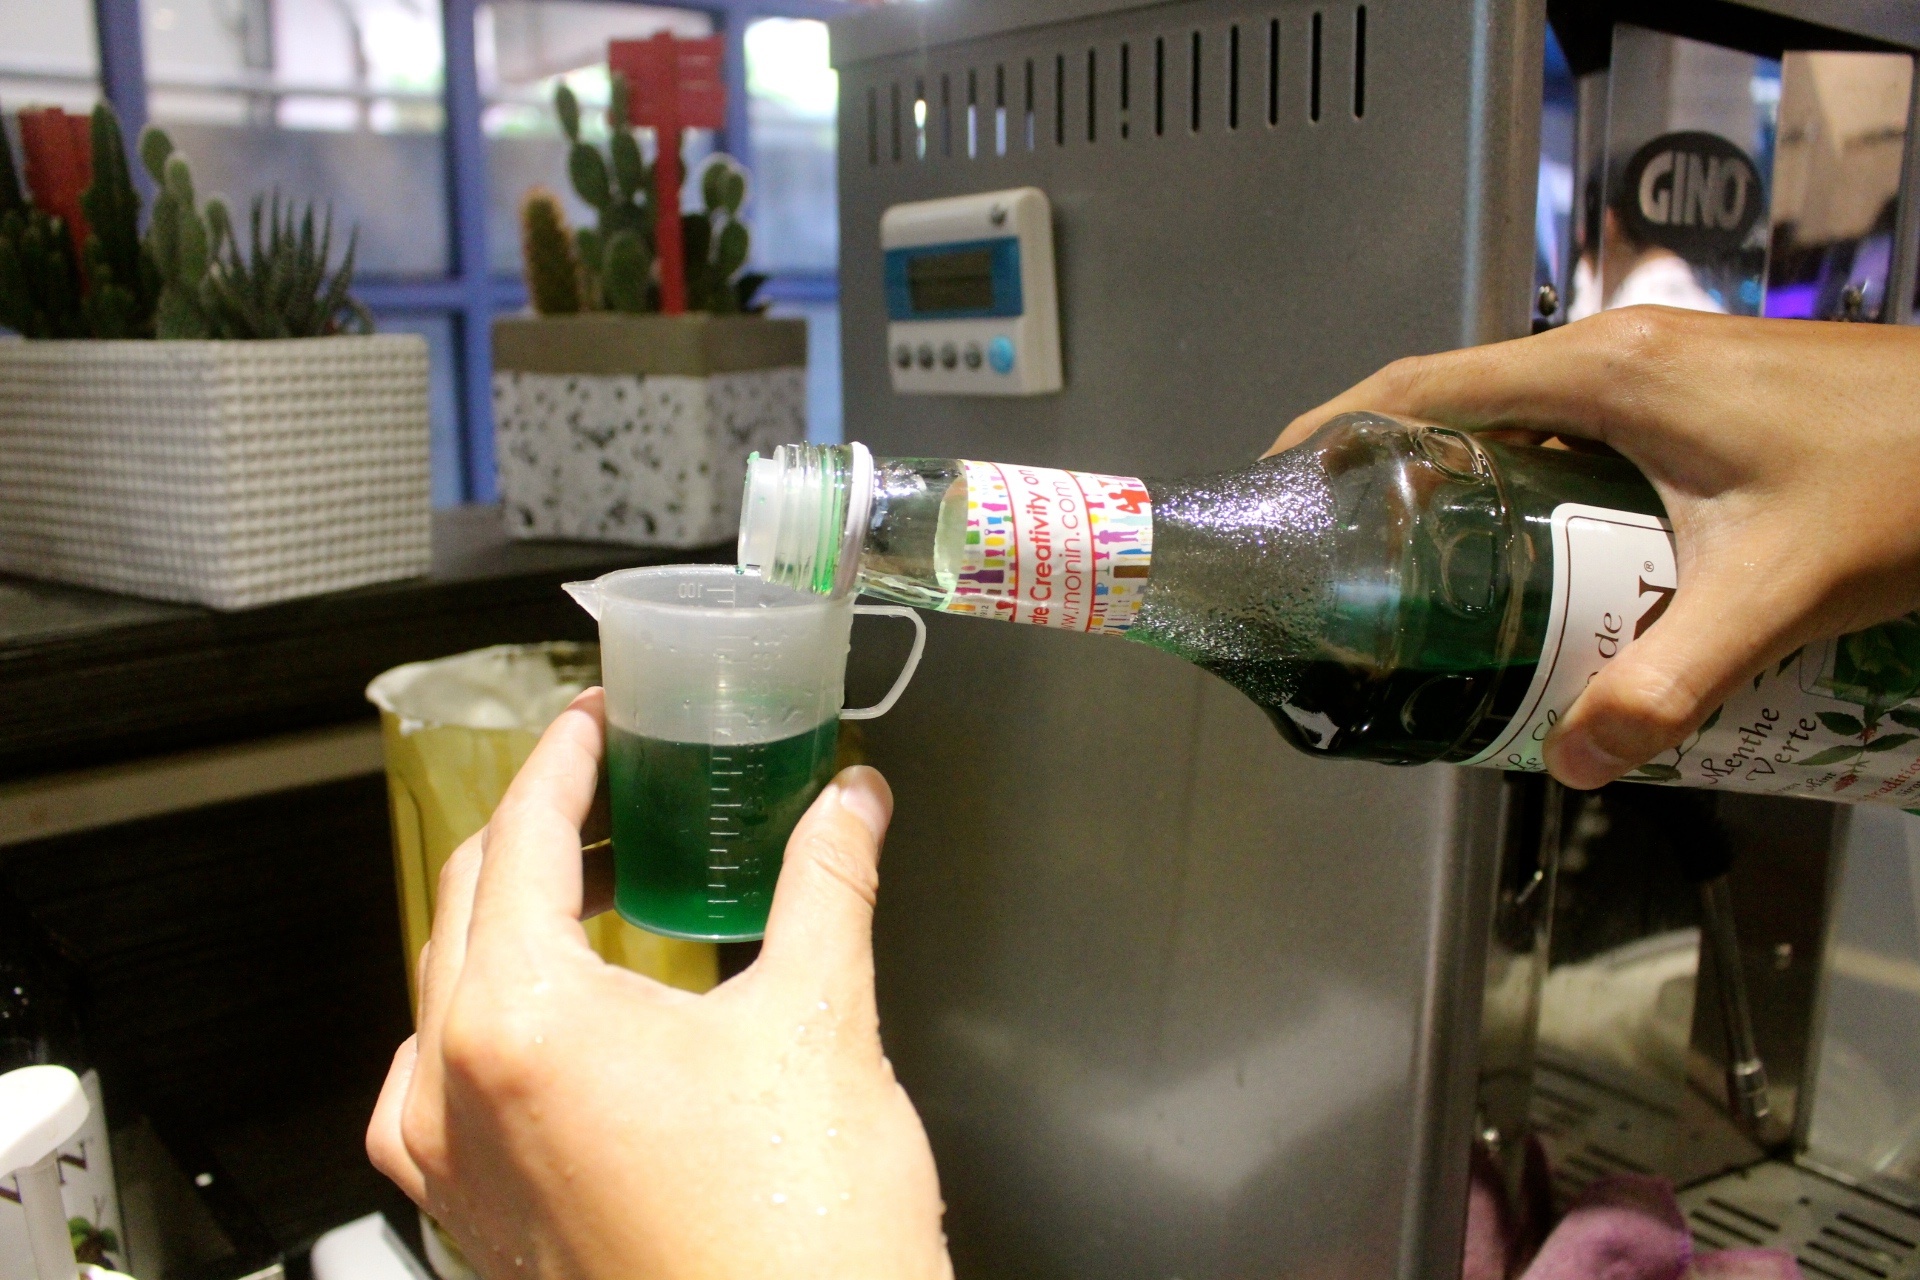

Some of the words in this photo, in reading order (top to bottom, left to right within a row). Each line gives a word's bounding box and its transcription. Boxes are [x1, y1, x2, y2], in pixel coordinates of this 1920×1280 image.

[1638, 149, 1748, 231] GINO
[1026, 489, 1053, 602] Creativity
[1595, 612, 1623, 659] de
[1701, 708, 1780, 785] Menthe
[1745, 718, 1817, 781] Verte
